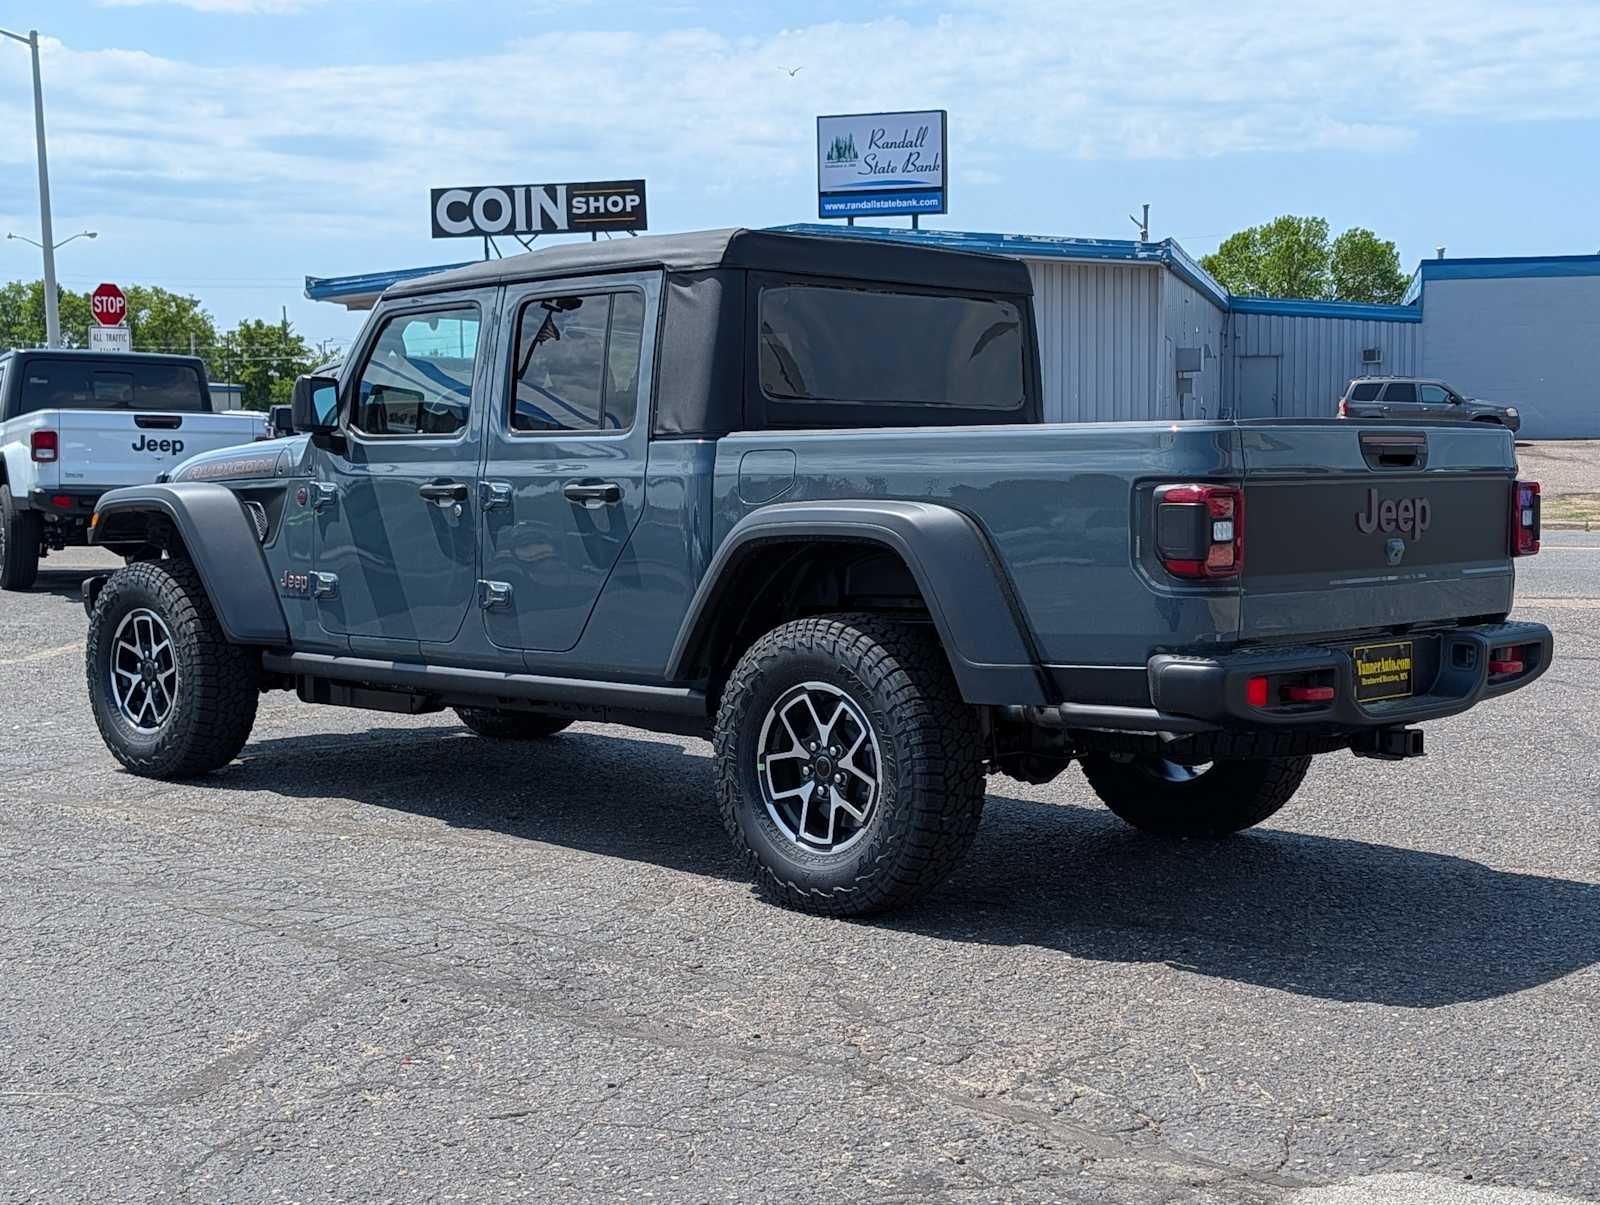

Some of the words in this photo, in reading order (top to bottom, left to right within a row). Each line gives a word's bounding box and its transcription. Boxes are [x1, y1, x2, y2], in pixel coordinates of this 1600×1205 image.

[868, 126, 928, 150] Randall
[857, 153, 898, 175] State
[902, 151, 940, 173] Bank
[436, 185, 569, 233] COIN
[572, 195, 640, 214] SHOP
[824, 199, 938, 210] www.randallstatebank.com
[94, 296, 124, 313] STOP
[93, 334, 102, 342] ALL
[106, 334, 127, 342] TRAFFIC
[132, 435, 184, 455] Jeep
[190, 459, 273, 479] RUBICON
[1354, 488, 1431, 541] Jeep
[281, 570, 308, 592] Jeep
